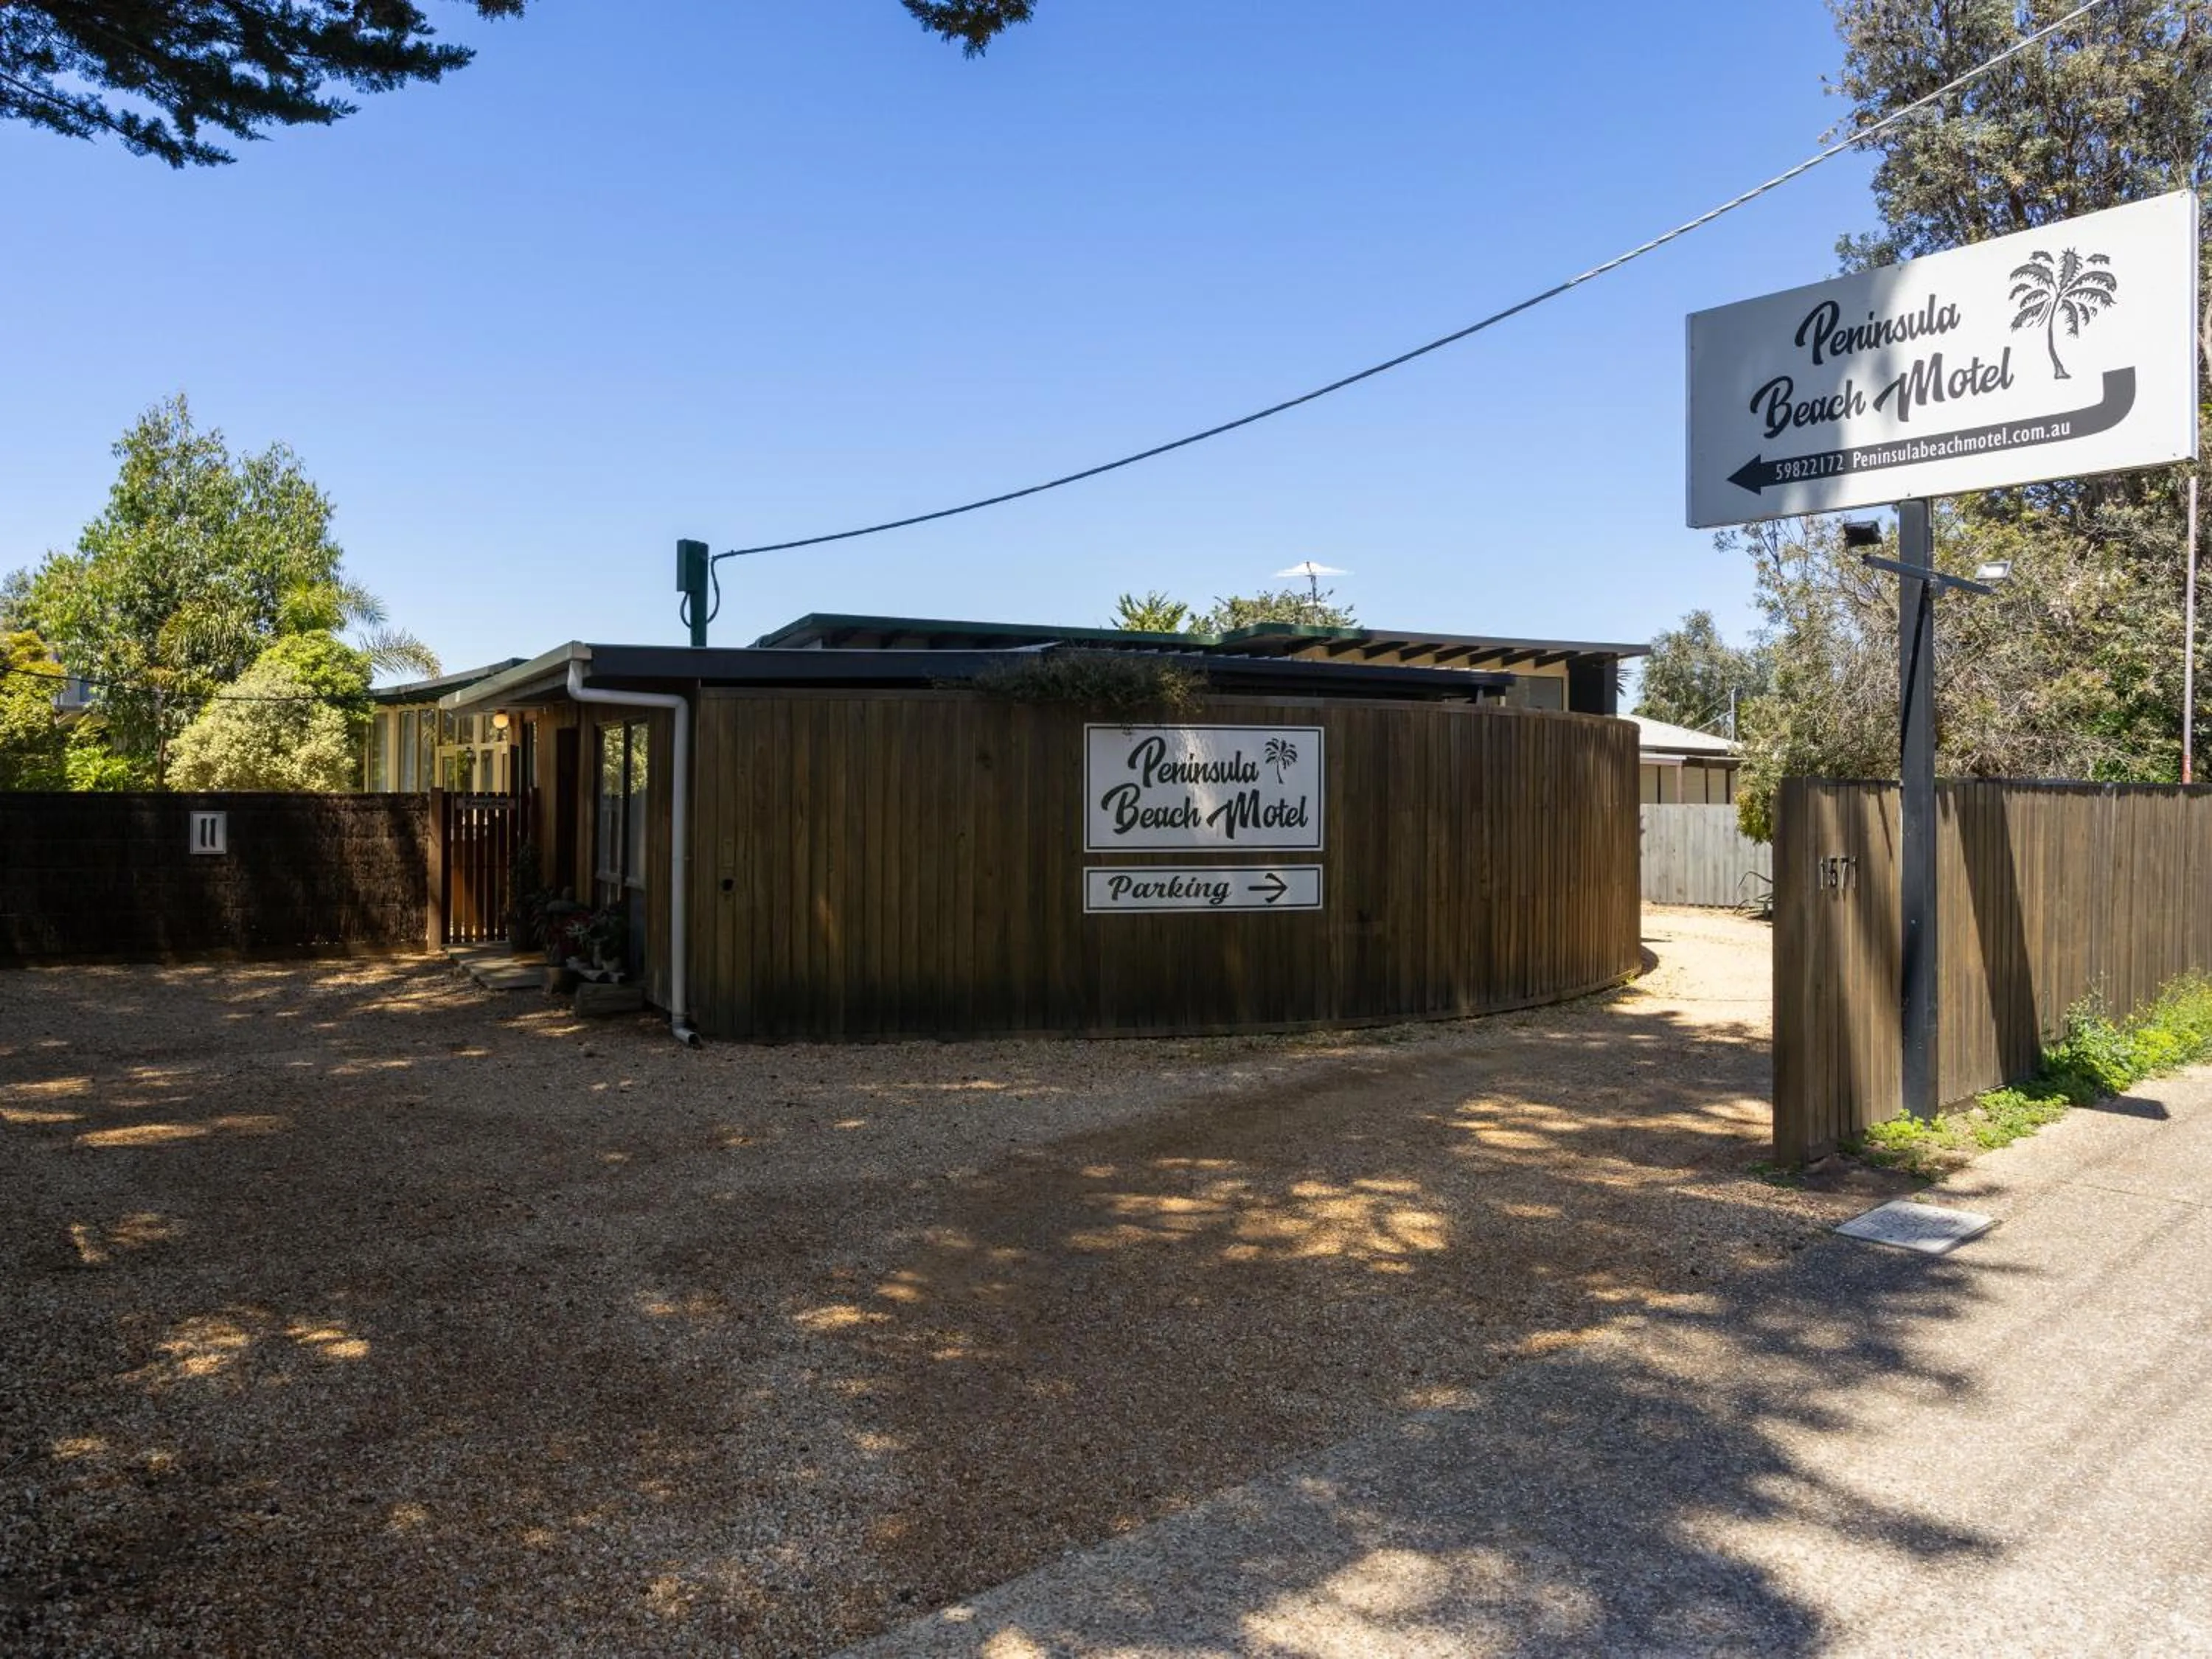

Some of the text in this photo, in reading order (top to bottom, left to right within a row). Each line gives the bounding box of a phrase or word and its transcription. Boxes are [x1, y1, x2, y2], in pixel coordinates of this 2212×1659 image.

[1795, 294, 1961, 366] Peninsula
[1750, 347, 2014, 439] Beach Motel
[1775, 421, 2071, 480] 59822172 Peninsulabeachmotel.com.au
[1127, 736, 1259, 788] Peninsula
[1100, 782, 1309, 840] Beach Motel
[1107, 874, 1233, 905] Parking
